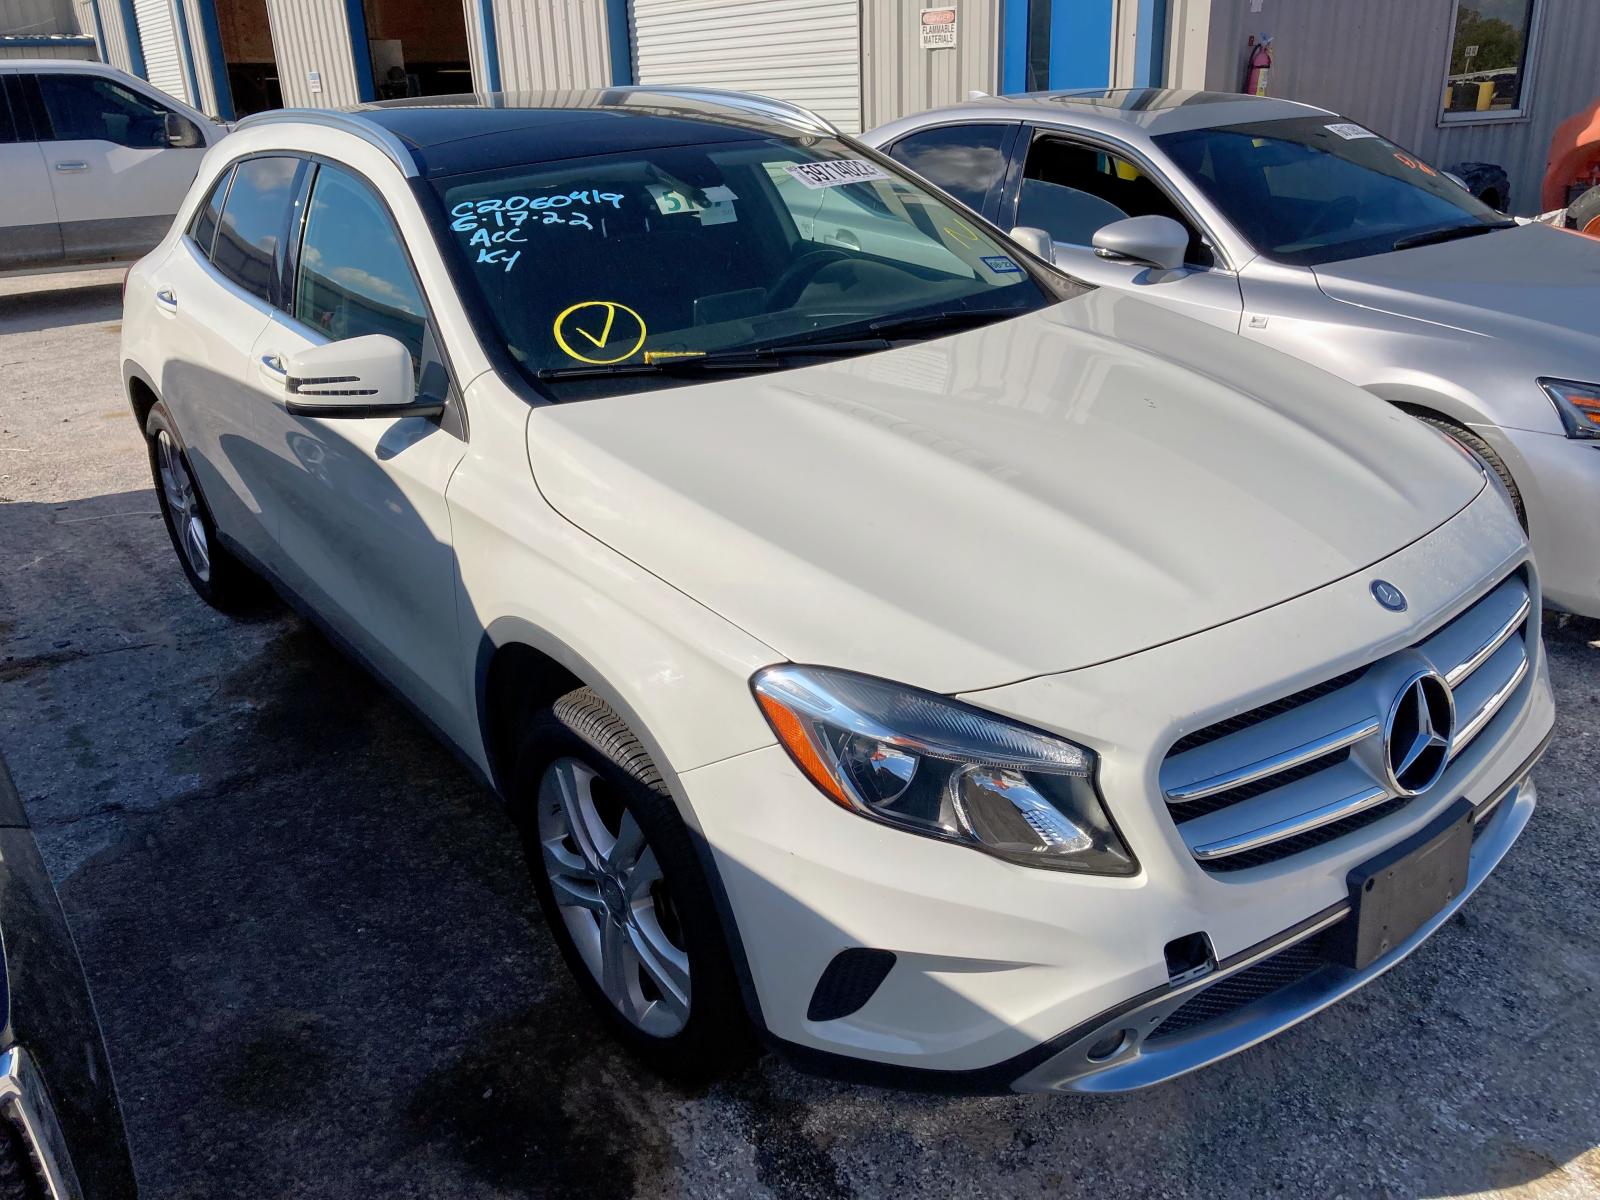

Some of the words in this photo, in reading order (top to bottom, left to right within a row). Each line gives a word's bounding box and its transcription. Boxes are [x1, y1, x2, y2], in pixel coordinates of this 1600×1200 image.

[922, 24, 955, 34] FLAMMABLE
[923, 34, 953, 44] MATERIALS
[797, 160, 876, 182] 59714022
